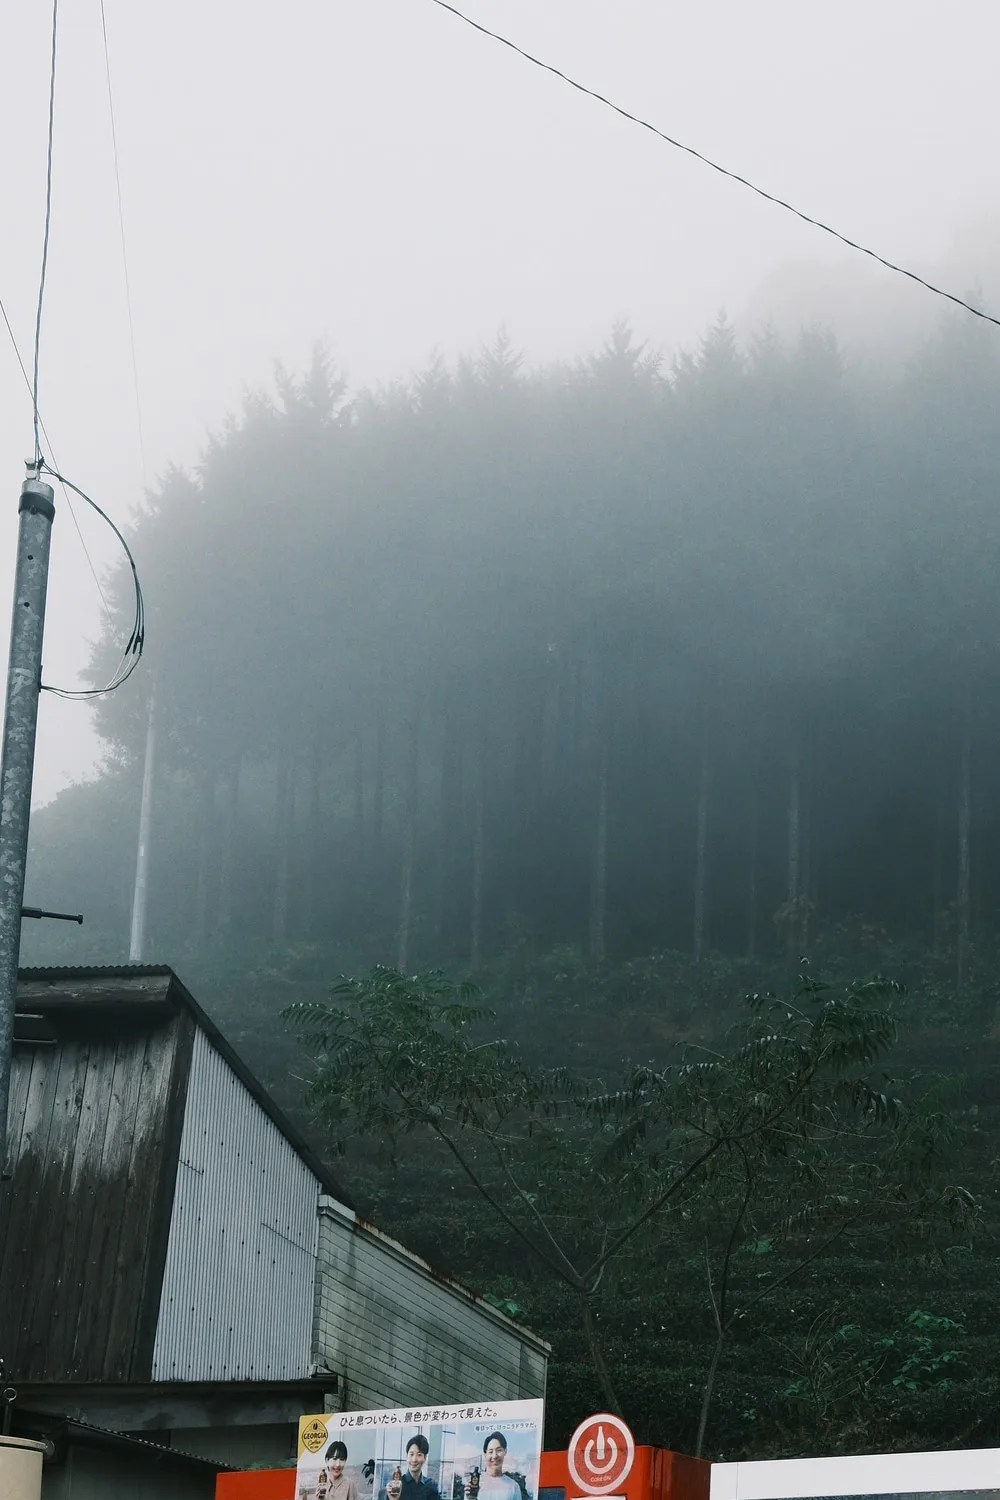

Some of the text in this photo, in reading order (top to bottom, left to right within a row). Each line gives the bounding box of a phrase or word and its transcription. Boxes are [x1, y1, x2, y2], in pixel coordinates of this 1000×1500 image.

[340, 1406, 498, 1427] ひと息ついたら、景色が変わって見えた。
[303, 1431, 327, 1440] GEORGIA
